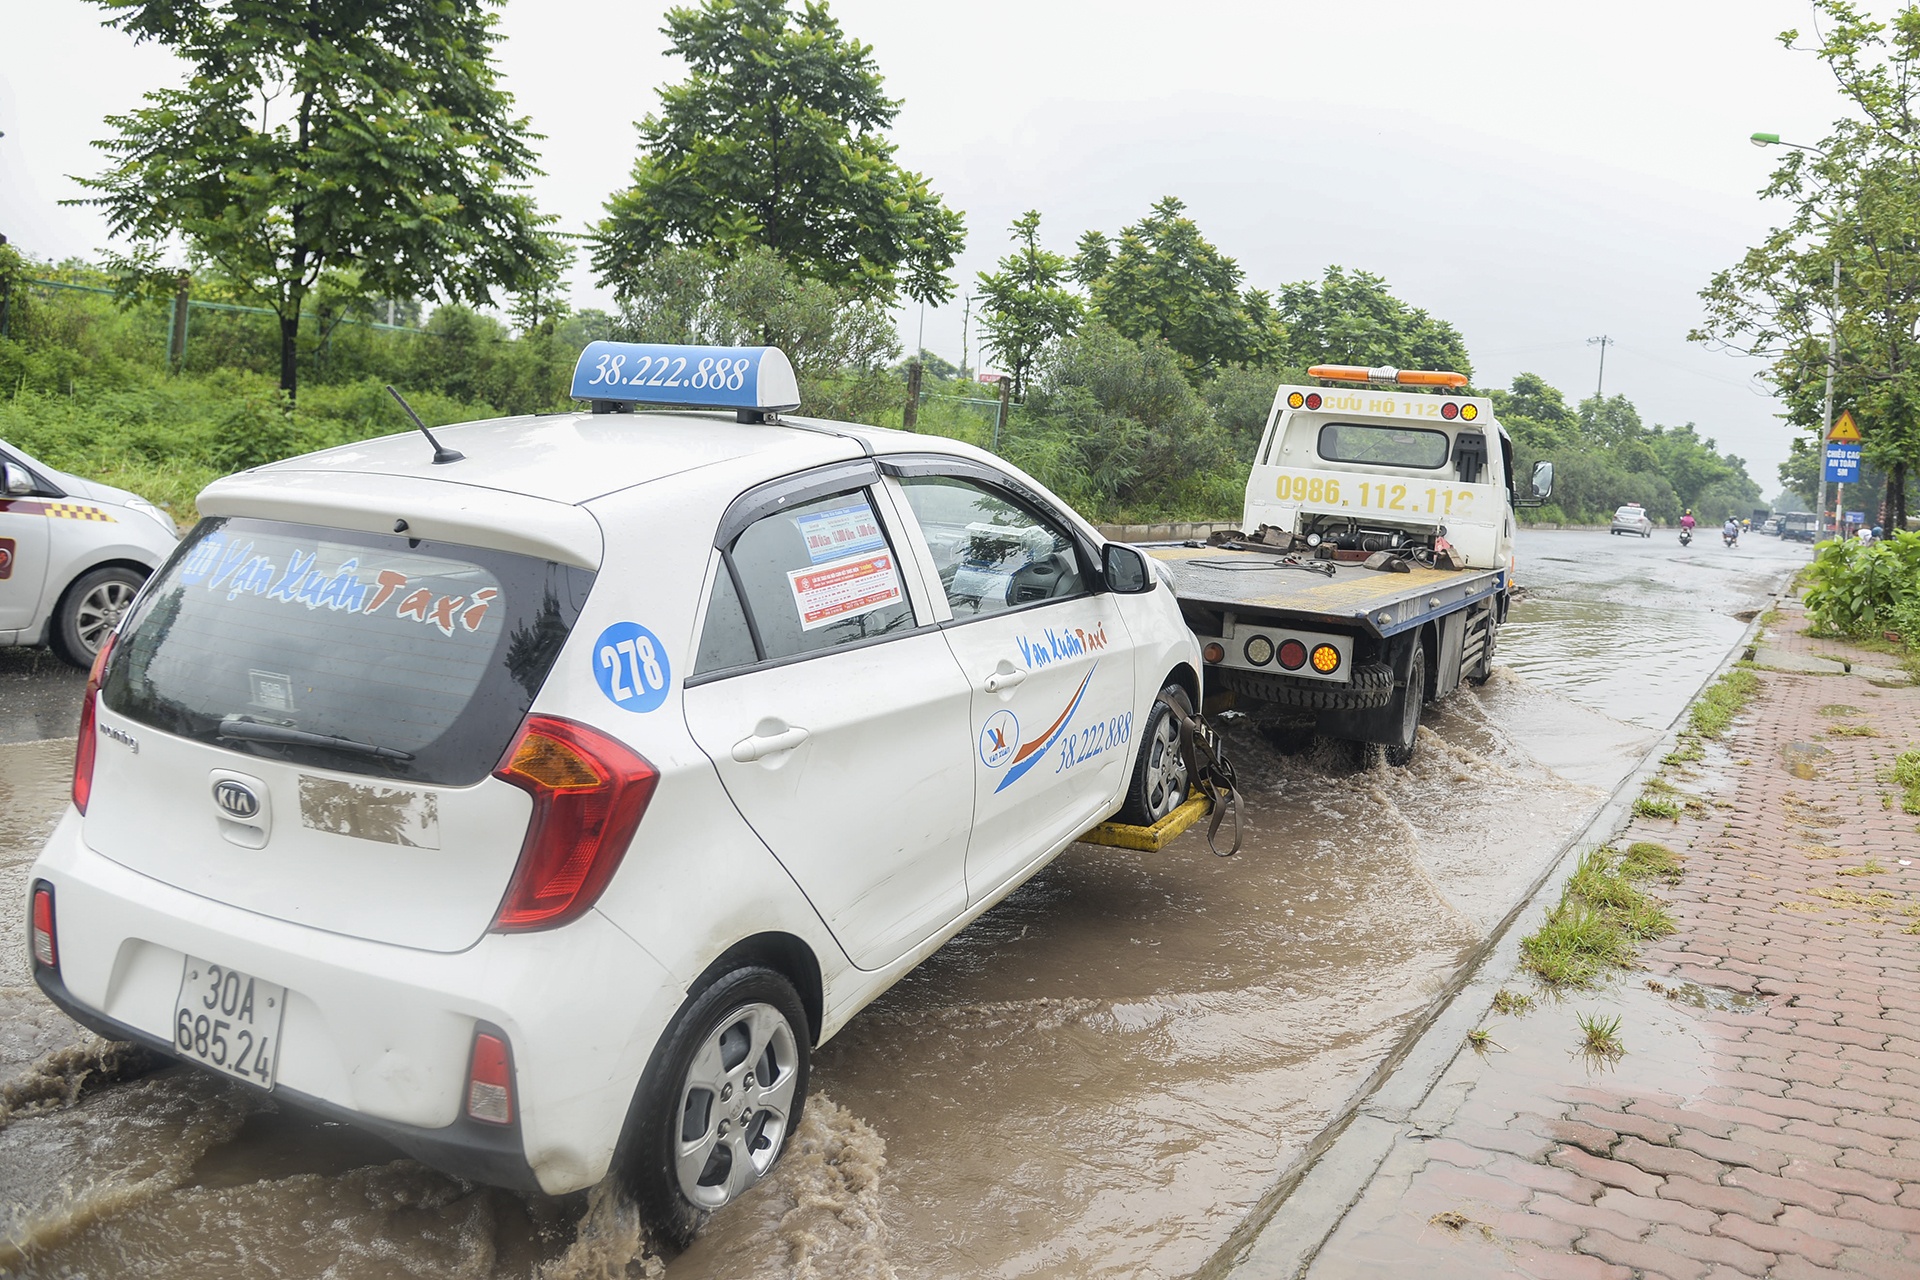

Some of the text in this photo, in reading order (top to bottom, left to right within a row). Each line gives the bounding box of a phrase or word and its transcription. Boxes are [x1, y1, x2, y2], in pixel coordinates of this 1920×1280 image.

[588, 353, 750, 391] 38.222.888
[1369, 397, 1395, 416] HỘ
[1403, 402, 1439, 417] 112
[1828, 459, 1839, 467] AN
[208, 538, 276, 601] Vạn
[266, 549, 368, 615] Xuân
[600, 635, 664, 702] 278
[1015, 621, 1108, 669] Vạn Xuân Taxi
[1055, 711, 1132, 774] 38.222.888
[217, 786, 251, 813] KIA
[203, 965, 255, 1025] 30A
[177, 1008, 269, 1083] 685.24
